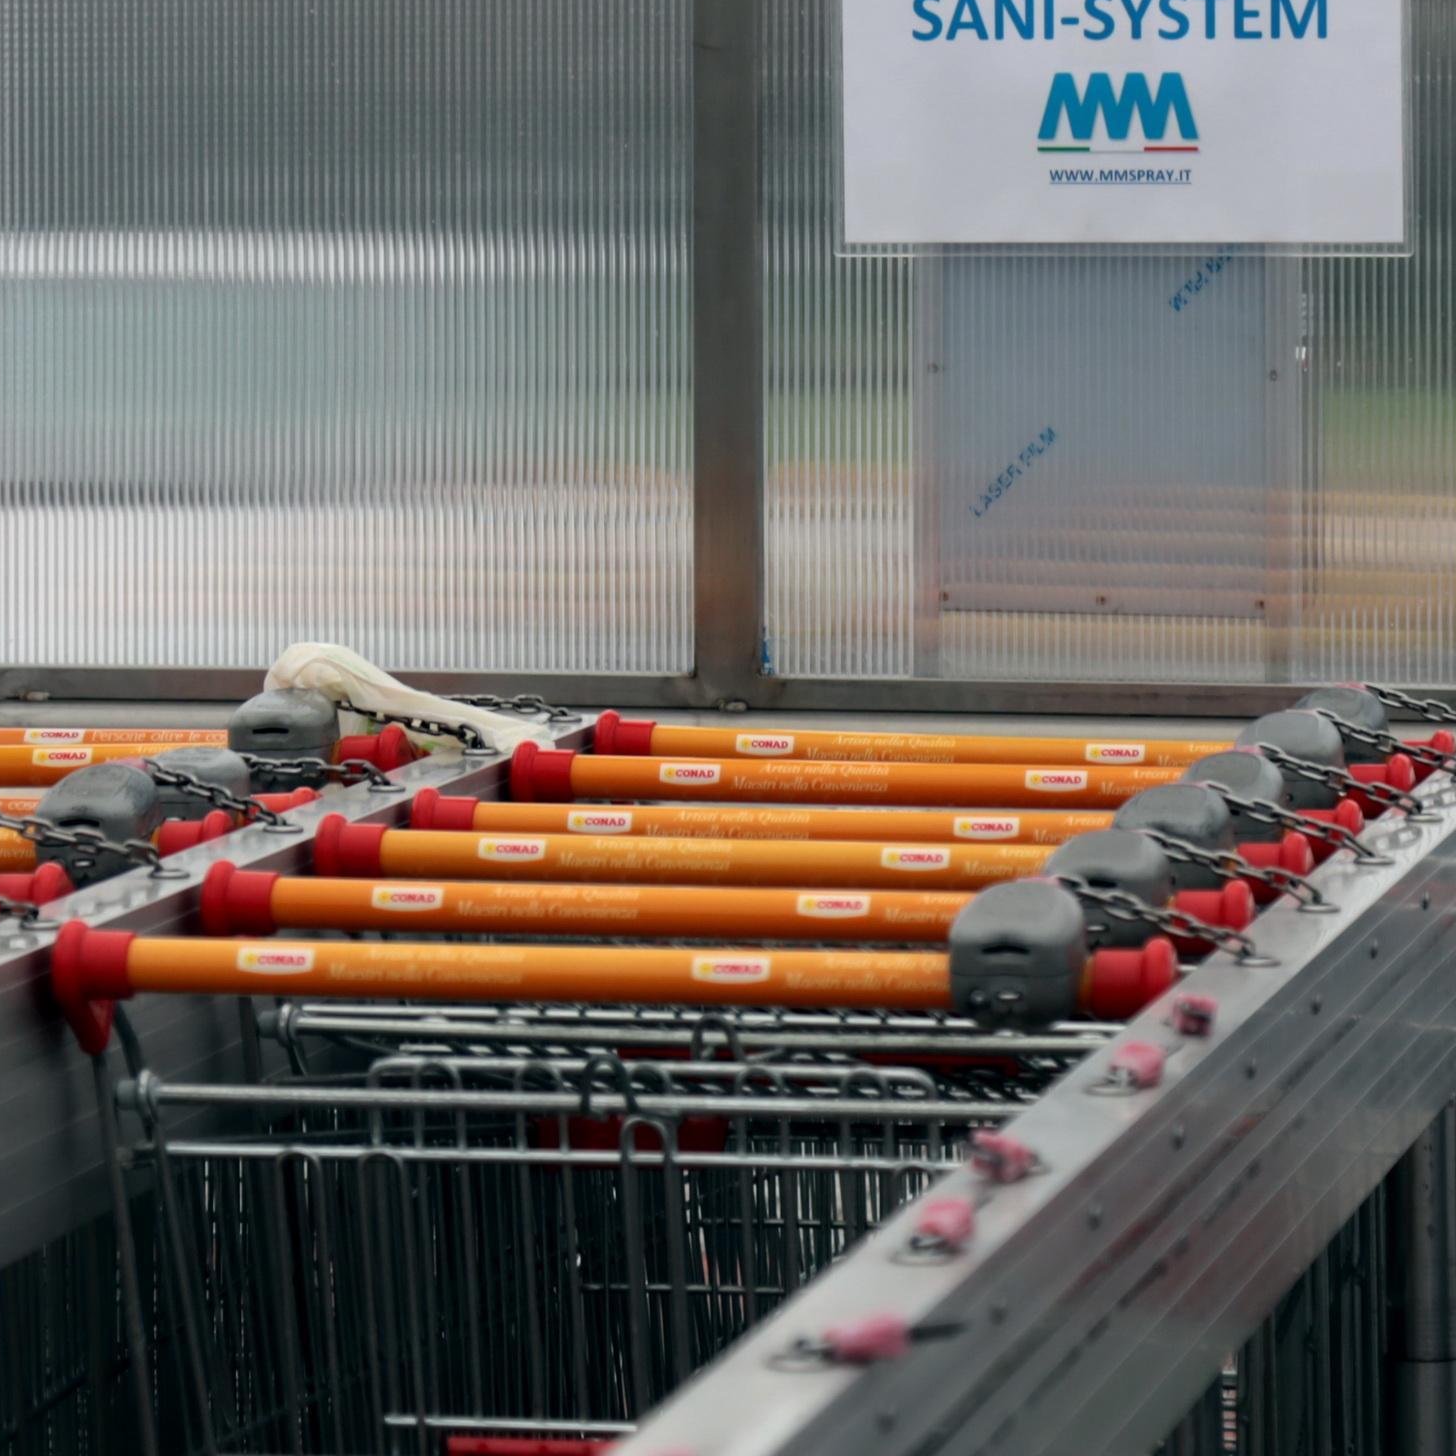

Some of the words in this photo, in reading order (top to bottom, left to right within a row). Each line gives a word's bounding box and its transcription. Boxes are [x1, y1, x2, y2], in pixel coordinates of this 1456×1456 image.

[1049, 169, 1192, 182] WWW.MMSPRAY.IT
[751, 740, 788, 749] CONAD
[48, 752, 87, 760] CONAD
[1101, 749, 1140, 757] CONAD
[675, 769, 714, 778] CONAD
[731, 776, 775, 790] Maestri
[779, 777, 807, 791] nella
[811, 778, 888, 791] Convenienza
[1042, 776, 1082, 784] CONAD
[584, 817, 626, 826] CONAD
[971, 823, 1013, 831] CONAD
[496, 844, 539, 854] CONAD
[900, 854, 943, 862] CONAD
[390, 893, 436, 904] CONAD
[816, 901, 862, 910] CONAD
[257, 955, 306, 966] CONAD
[712, 963, 762, 974] CONAD
